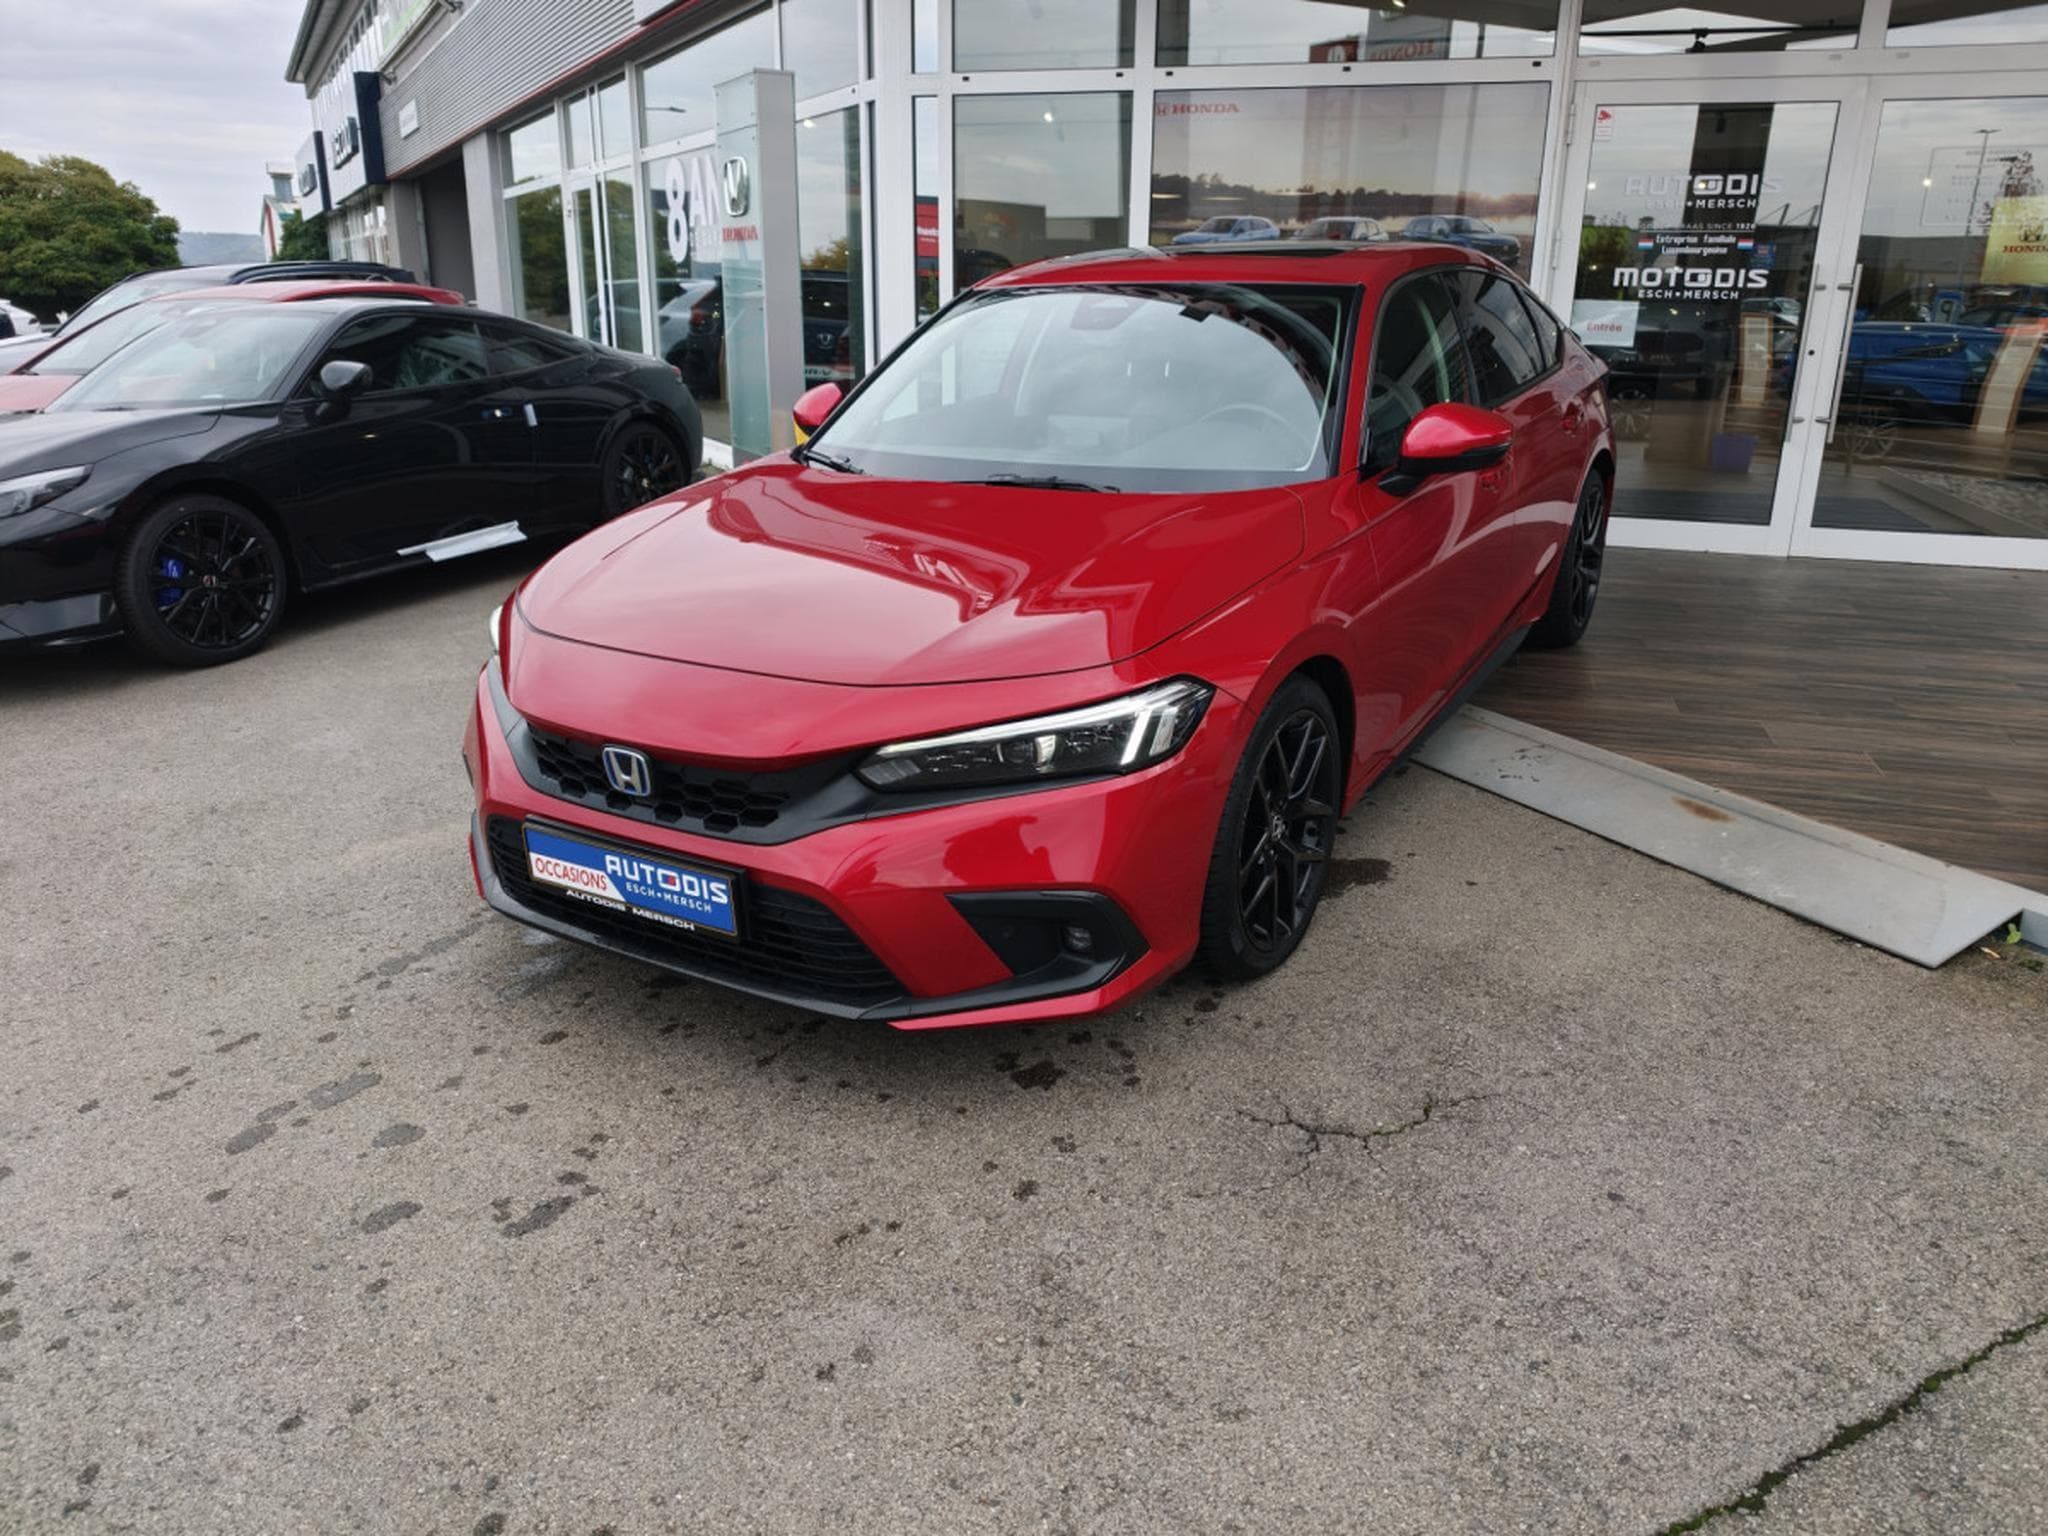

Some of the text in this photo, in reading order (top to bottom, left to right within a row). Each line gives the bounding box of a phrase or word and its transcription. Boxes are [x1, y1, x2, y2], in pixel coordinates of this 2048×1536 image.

[1171, 103, 1239, 114] HONDA
[665, 157, 689, 263] 8
[723, 225, 758, 241] HONDA
[1613, 266, 1770, 289] MOTODIS
[1586, 321, 1623, 333] Entrée
[535, 856, 608, 892] OCCASIONS
[604, 854, 729, 905] AUTODIS
[565, 888, 696, 931] AUTODIS MERSCH
